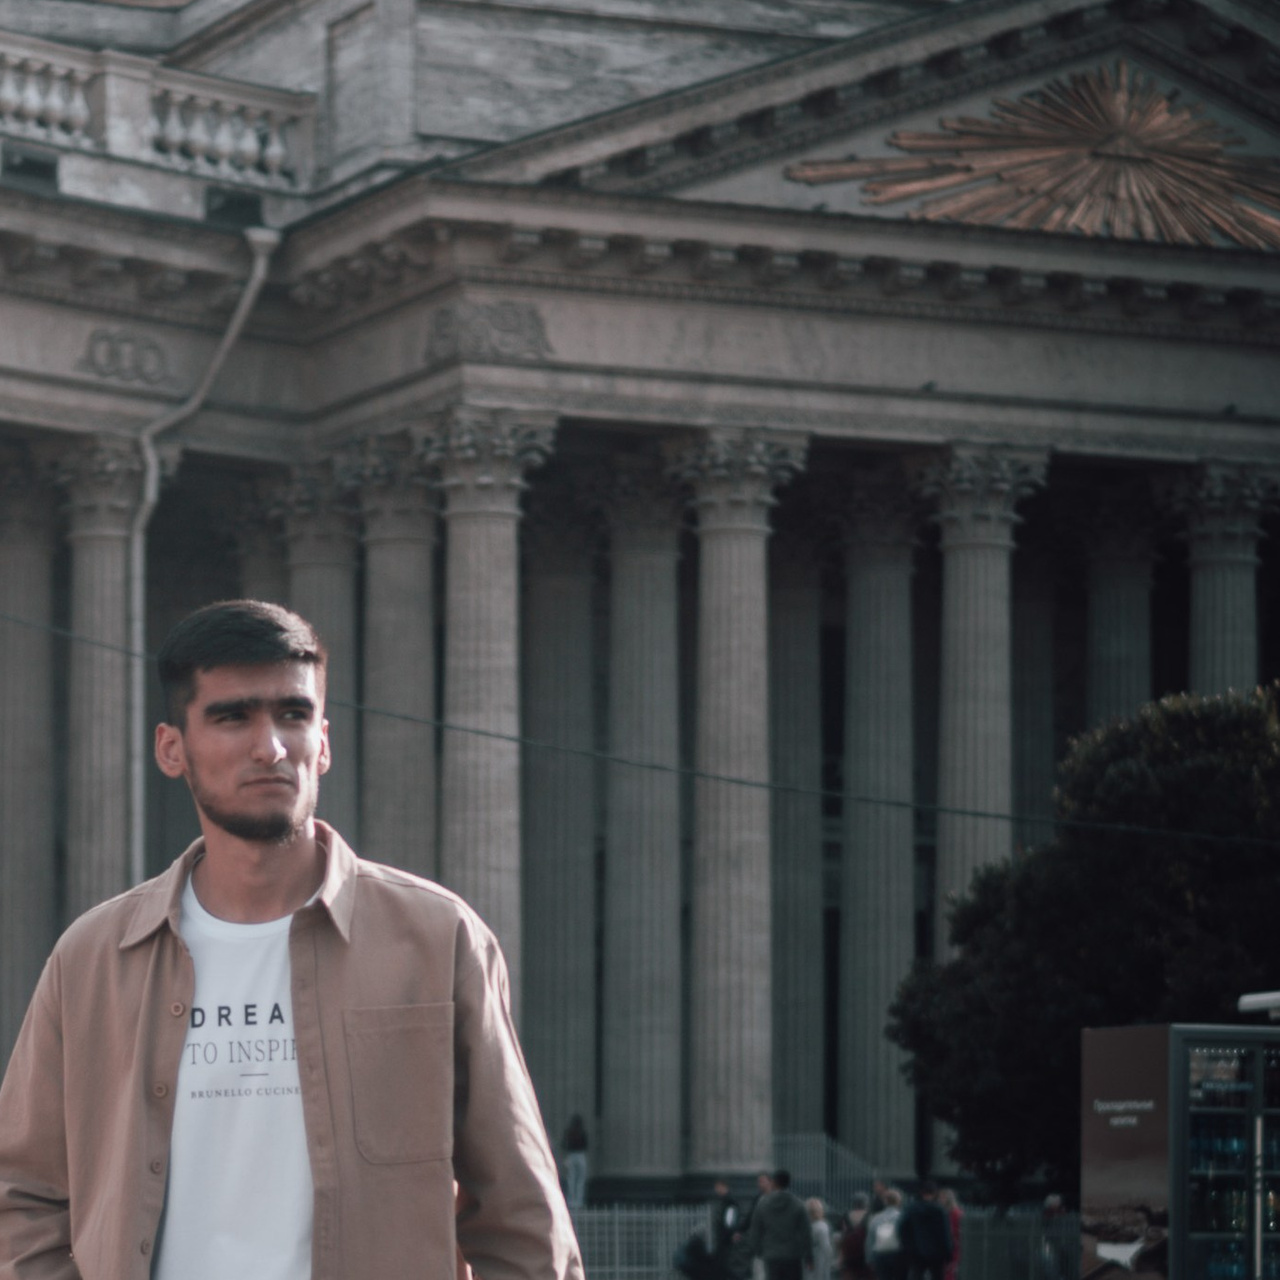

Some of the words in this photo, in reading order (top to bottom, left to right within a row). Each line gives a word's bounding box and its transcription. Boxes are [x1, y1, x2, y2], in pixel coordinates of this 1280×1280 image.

[190, 1003, 285, 1028] DREA
[186, 1041, 218, 1065] TO
[191, 1087, 252, 1099] BRUNELLO
